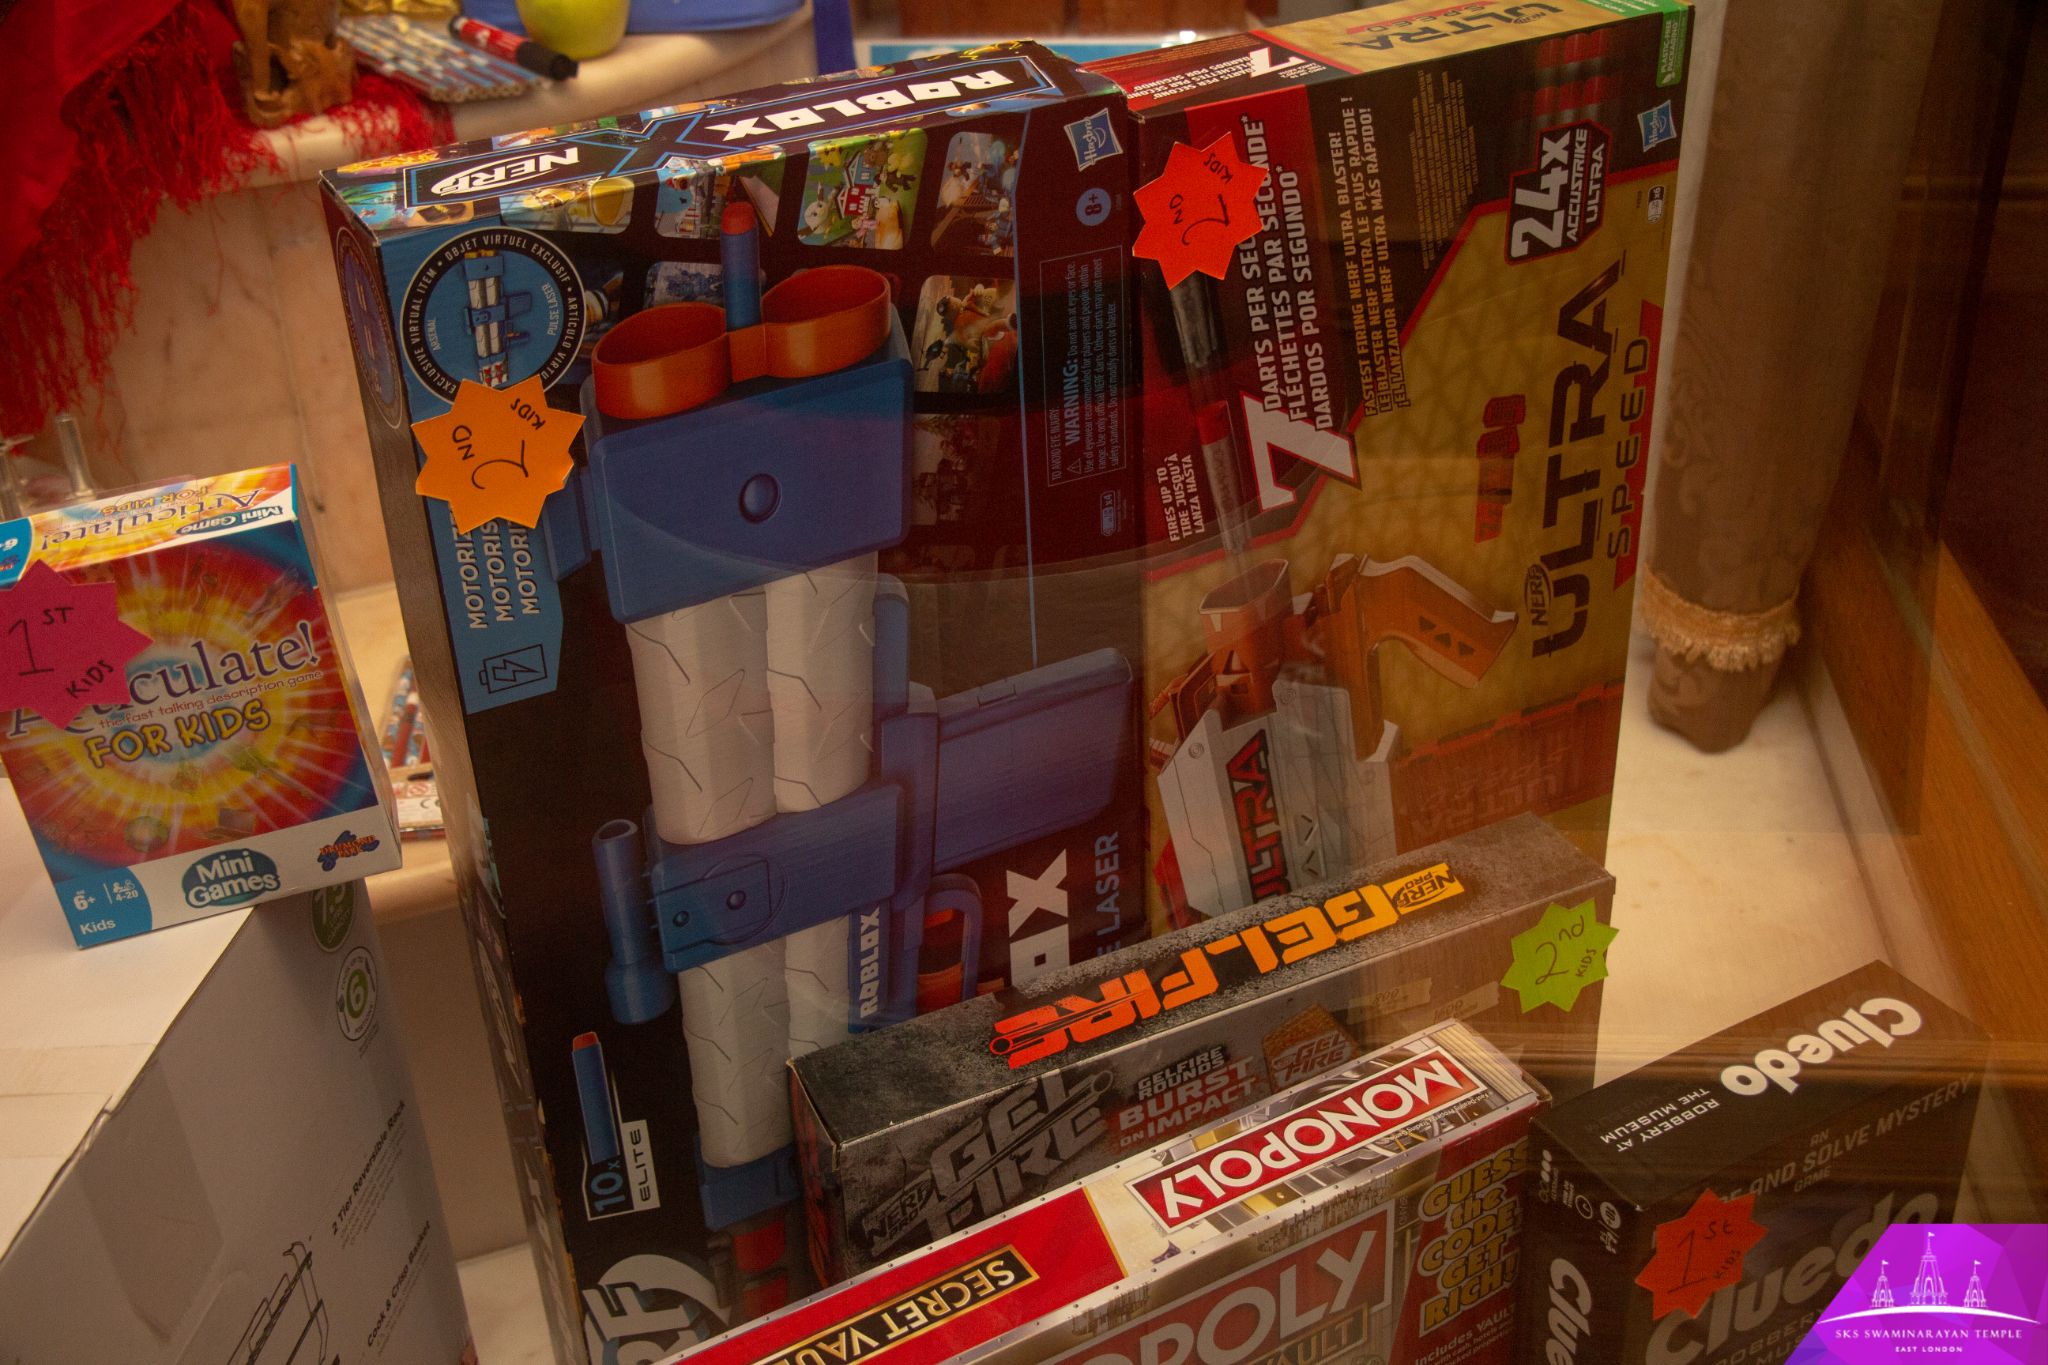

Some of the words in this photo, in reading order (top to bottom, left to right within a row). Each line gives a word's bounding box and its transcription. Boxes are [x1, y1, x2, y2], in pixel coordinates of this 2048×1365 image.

[1340, 3, 1567, 50] ULTRA
[1367, 4, 1485, 32] SPEED
[1667, 22, 1679, 72] PACKAGING
[704, 70, 1015, 142] ROBLOX
[1079, 116, 1104, 165] Hasbro
[1342, 108, 1362, 168] RAPIDE
[1359, 108, 1379, 174] RÁPIDO!
[431, 147, 580, 198] NERF
[1203, 152, 1233, 184] KIDS
[1328, 132, 1350, 205] BLASTER!
[1566, 128, 1588, 242] ACCUSTRIKE
[1585, 143, 1605, 224] ULTRA
[1084, 192, 1104, 218] 8+
[1352, 172, 1368, 212] PLUS
[1366, 178, 1384, 211] MÁS
[1340, 209, 1356, 257] ULTRA
[1357, 215, 1370, 233] LE
[1373, 215, 1389, 261] ULTRA
[444, 238, 478, 262] OBJET
[482, 233, 528, 250] VIRTUEL
[530, 243, 571, 284] EXCLUSIF
[1240, 235, 1262, 280] SEC
[1263, 238, 1287, 283] PAR
[1346, 260, 1362, 300] NERF
[1360, 238, 1376, 284] ULTRA
[416, 270, 437, 295] ITEM
[541, 282, 559, 312] LASER
[1379, 265, 1394, 304] NERF
[408, 297, 423, 345] VIRTUAL
[547, 313, 560, 336] PULSE
[563, 296, 581, 350] ARTÍCULO
[1246, 286, 1271, 332] PER
[1296, 288, 1321, 337] POR
[1352, 303, 1369, 354] FIRING
[1366, 287, 1381, 326] NERF
[541, 351, 567, 380] VIRTU
[1271, 289, 1309, 421] FLÉCHETTES
[1371, 330, 1390, 391] BLASTER
[1384, 307, 1404, 384] LANZADOR
[413, 345, 457, 394] EXCLUSIVE
[1254, 338, 1284, 412] DARTS
[1305, 342, 1334, 431] DARDOS
[1358, 359, 1379, 416] FASTEST
[510, 398, 546, 430] KIDS
[1062, 358, 1080, 446] WARNING:
[1379, 390, 1392, 412] LE
[1533, 260, 1621, 658] ULTRA
[1608, 337, 1650, 560] SPEED
[1156, 467, 1168, 484] TO
[1160, 486, 1173, 504] UP
[1164, 452, 1187, 507] JUSQU'À
[1181, 454, 1197, 493] HASTA
[41, 487, 266, 550] Articulate!
[103, 495, 158, 516] KIDS
[242, 505, 283, 521] Mini
[1164, 506, 1181, 542] FIRES
[1178, 509, 1193, 538] TIRE
[1189, 495, 1205, 534] LANZA
[450, 510, 488, 629] MOTORIZ
[508, 520, 541, 615] MOTORI
[1524, 563, 1552, 628] NERF
[66, 658, 115, 699] KIDS
[98, 717, 124, 729] the
[125, 708, 154, 723] fast
[159, 700, 205, 719] talking
[206, 678, 286, 704] description
[288, 670, 323, 687] game
[84, 722, 172, 769] FOR
[174, 698, 272, 748] KIDS
[185, 872, 281, 909] Games
[196, 850, 255, 885] Mini
[1094, 831, 1121, 936] LASER
[1393, 873, 1456, 909] NERF
[1404, 871, 1433, 890] PRO
[73, 893, 97, 912] 6+
[1006, 847, 1071, 992] OX
[79, 918, 117, 936] Kids
[859, 905, 880, 1019] ROBLOX
[1576, 948, 1597, 978] KIDS
[1137, 1045, 1225, 1091] GELFIRE
[1720, 997, 1923, 1097] Cluedo
[1119, 1055, 1256, 1132] BURST
[1138, 1055, 1226, 1102] ROUNDS
[1677, 1088, 1711, 1105] THE
[930, 1073, 1106, 1199] GEL
[1119, 1131, 1144, 1147] ON
[1147, 1078, 1256, 1142] IMPACT
[1600, 1103, 1679, 1144] MUSEUM
[1639, 1098, 1721, 1143] ROBBERY
[1750, 1161, 1797, 1197] AND
[1803, 1123, 1871, 1173] SOLVE
[1876, 1073, 1975, 1137] MYSTERY
[1162, 1057, 1464, 1220] MONOPOLY
[1616, 1138, 1635, 1153] AT
[1809, 1127, 1830, 1147] AN
[331, 1221, 338, 1236] 2
[338, 1196, 353, 1222] Tier
[352, 1131, 388, 1196] Reversible
[630, 1127, 651, 1203] ELITE
[1793, 1165, 1833, 1192] GAME
[862, 1178, 935, 1239] NERF
[888, 1208, 919, 1240] PRO
[1451, 1187, 1504, 1230] the
[1441, 1233, 1507, 1289] GET
[1715, 1249, 1742, 1280] KIDS
[880, 1259, 1016, 1341] SECRET
[1079, 1230, 1378, 1365] POLY
[1424, 1253, 1518, 1331] RICH!
[1546, 1257, 1593, 1365] Clue
[367, 1311, 387, 1347] Cook
[792, 1326, 881, 1365] VAU
[1415, 1329, 1474, 1365] Includes
